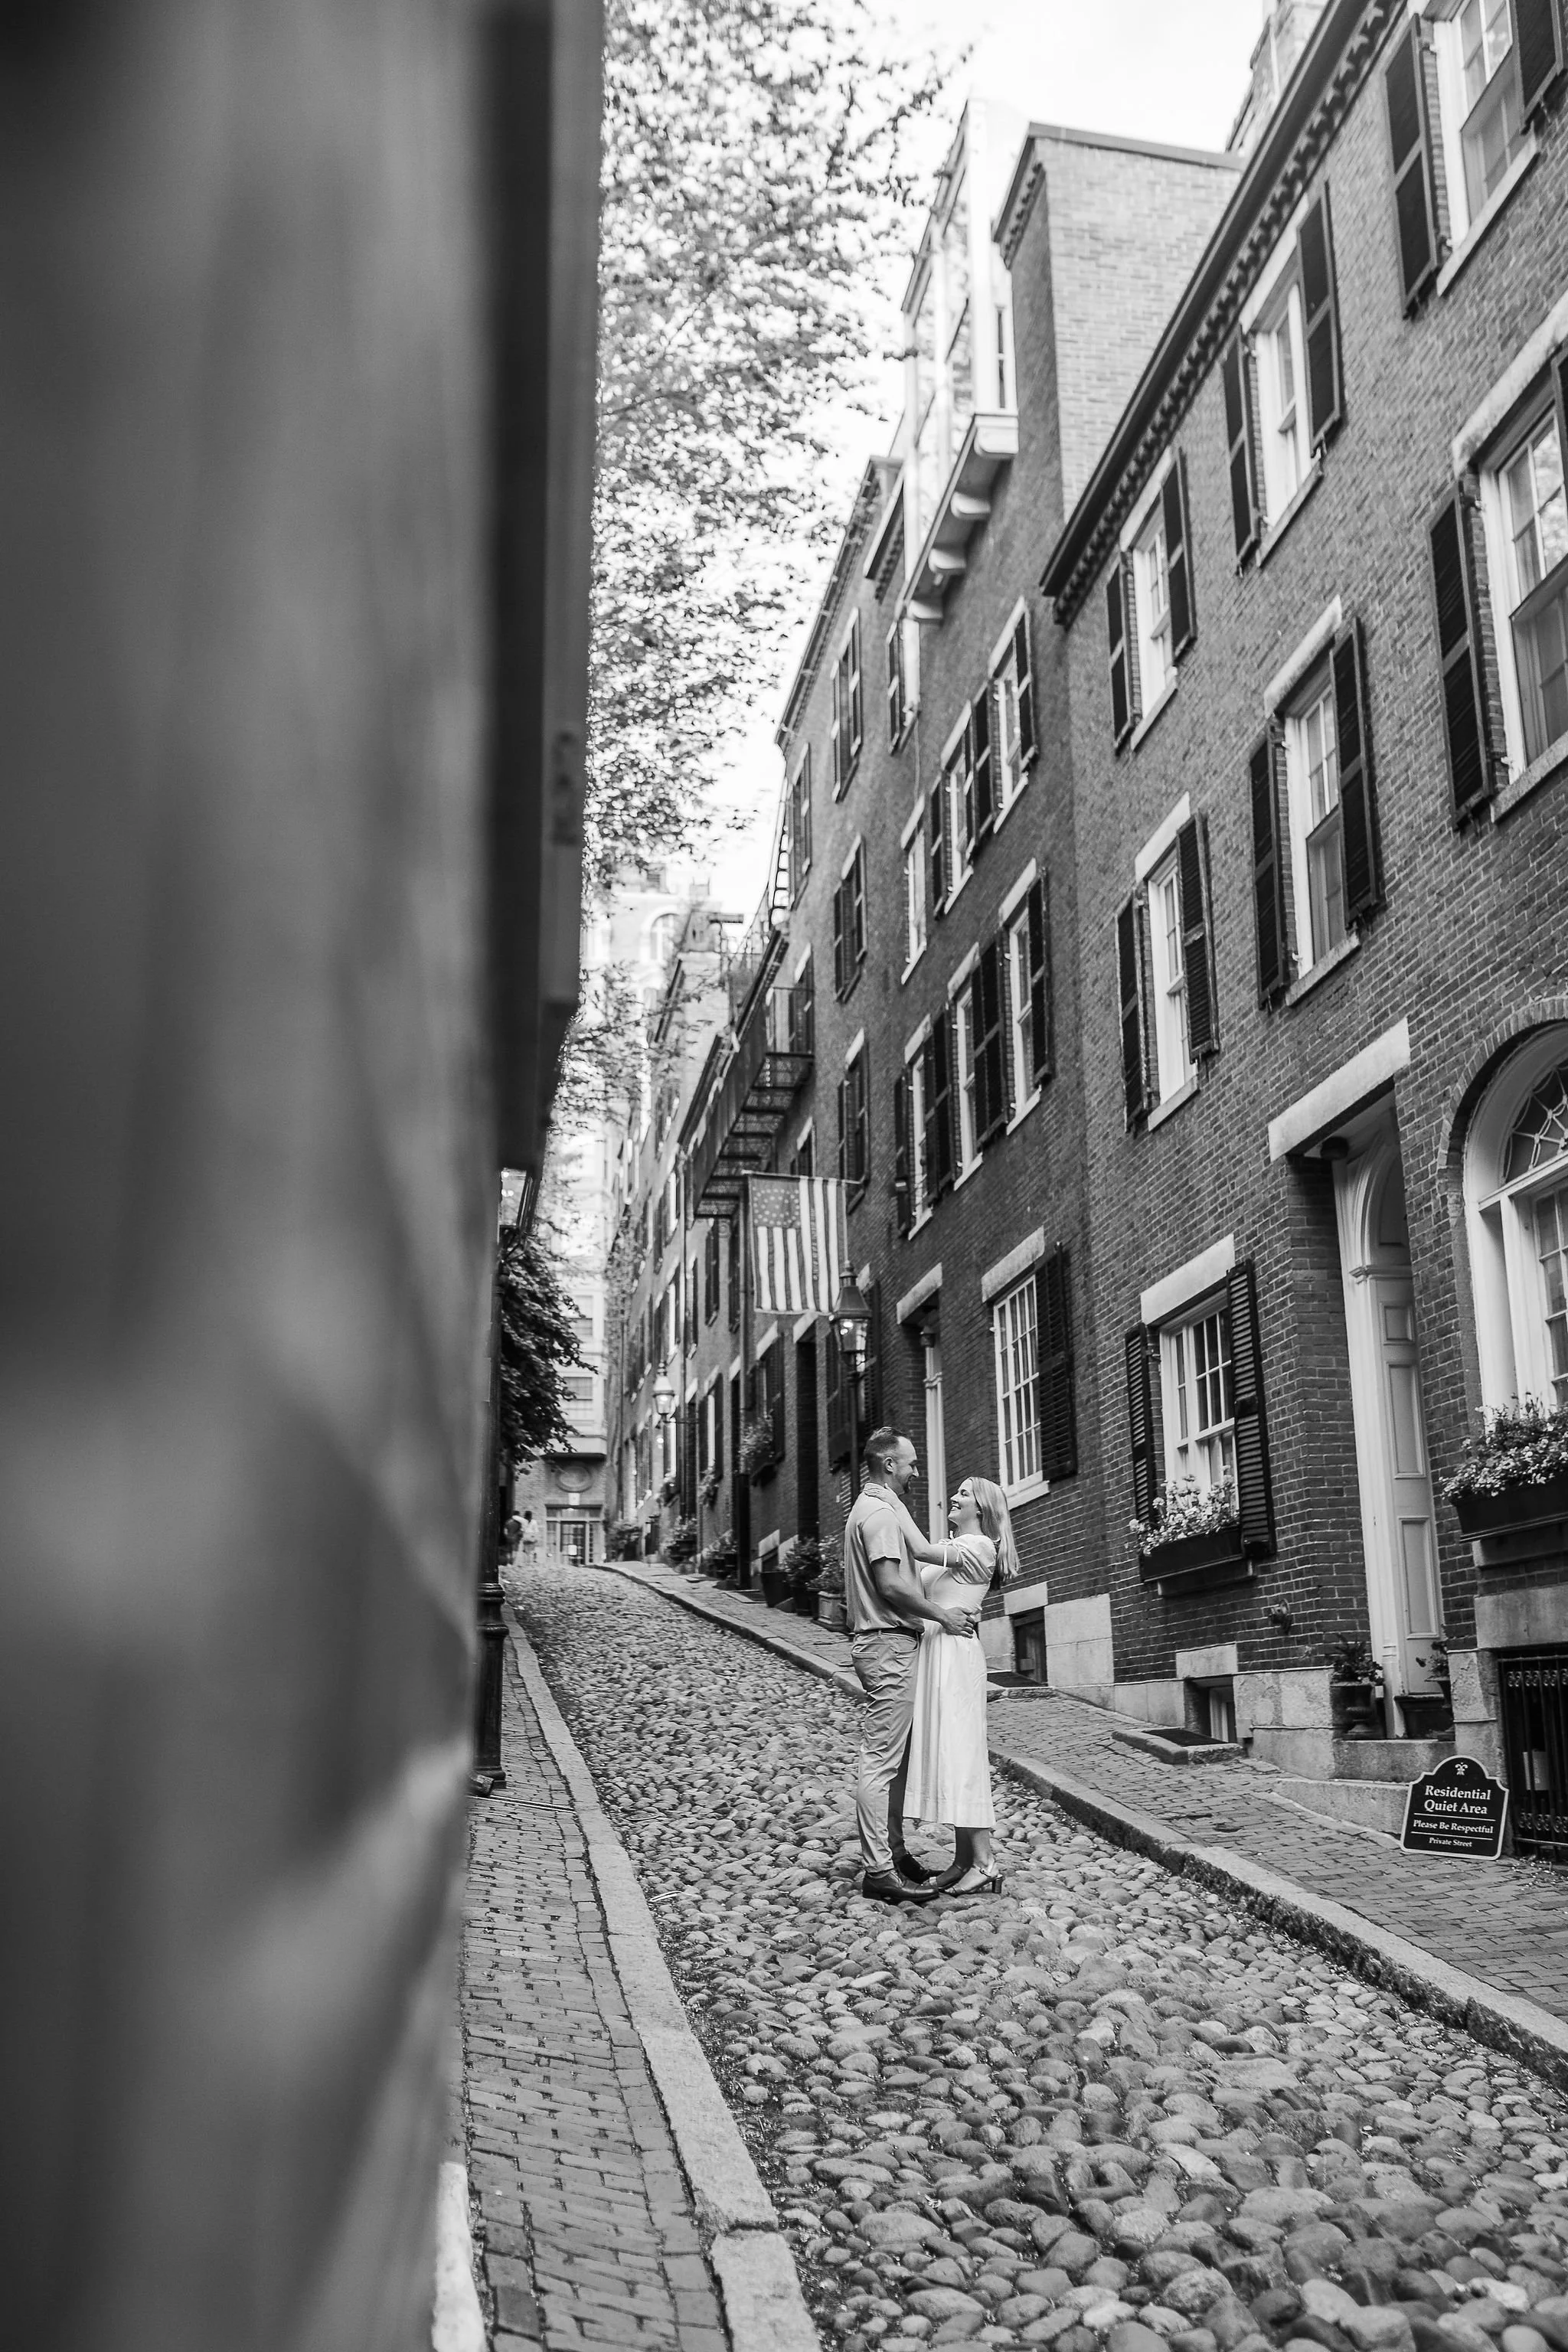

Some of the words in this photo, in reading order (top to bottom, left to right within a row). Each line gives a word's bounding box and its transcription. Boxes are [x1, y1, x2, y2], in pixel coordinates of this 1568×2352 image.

[1425, 1785, 1491, 1800] Residential
[1424, 1799, 1457, 1812] Quiet
[1459, 1802, 1488, 1814] Area
[1413, 1819, 1438, 1829] Please
[1439, 1821, 1449, 1830] Be
[1451, 1823, 1493, 1834] Respectful
